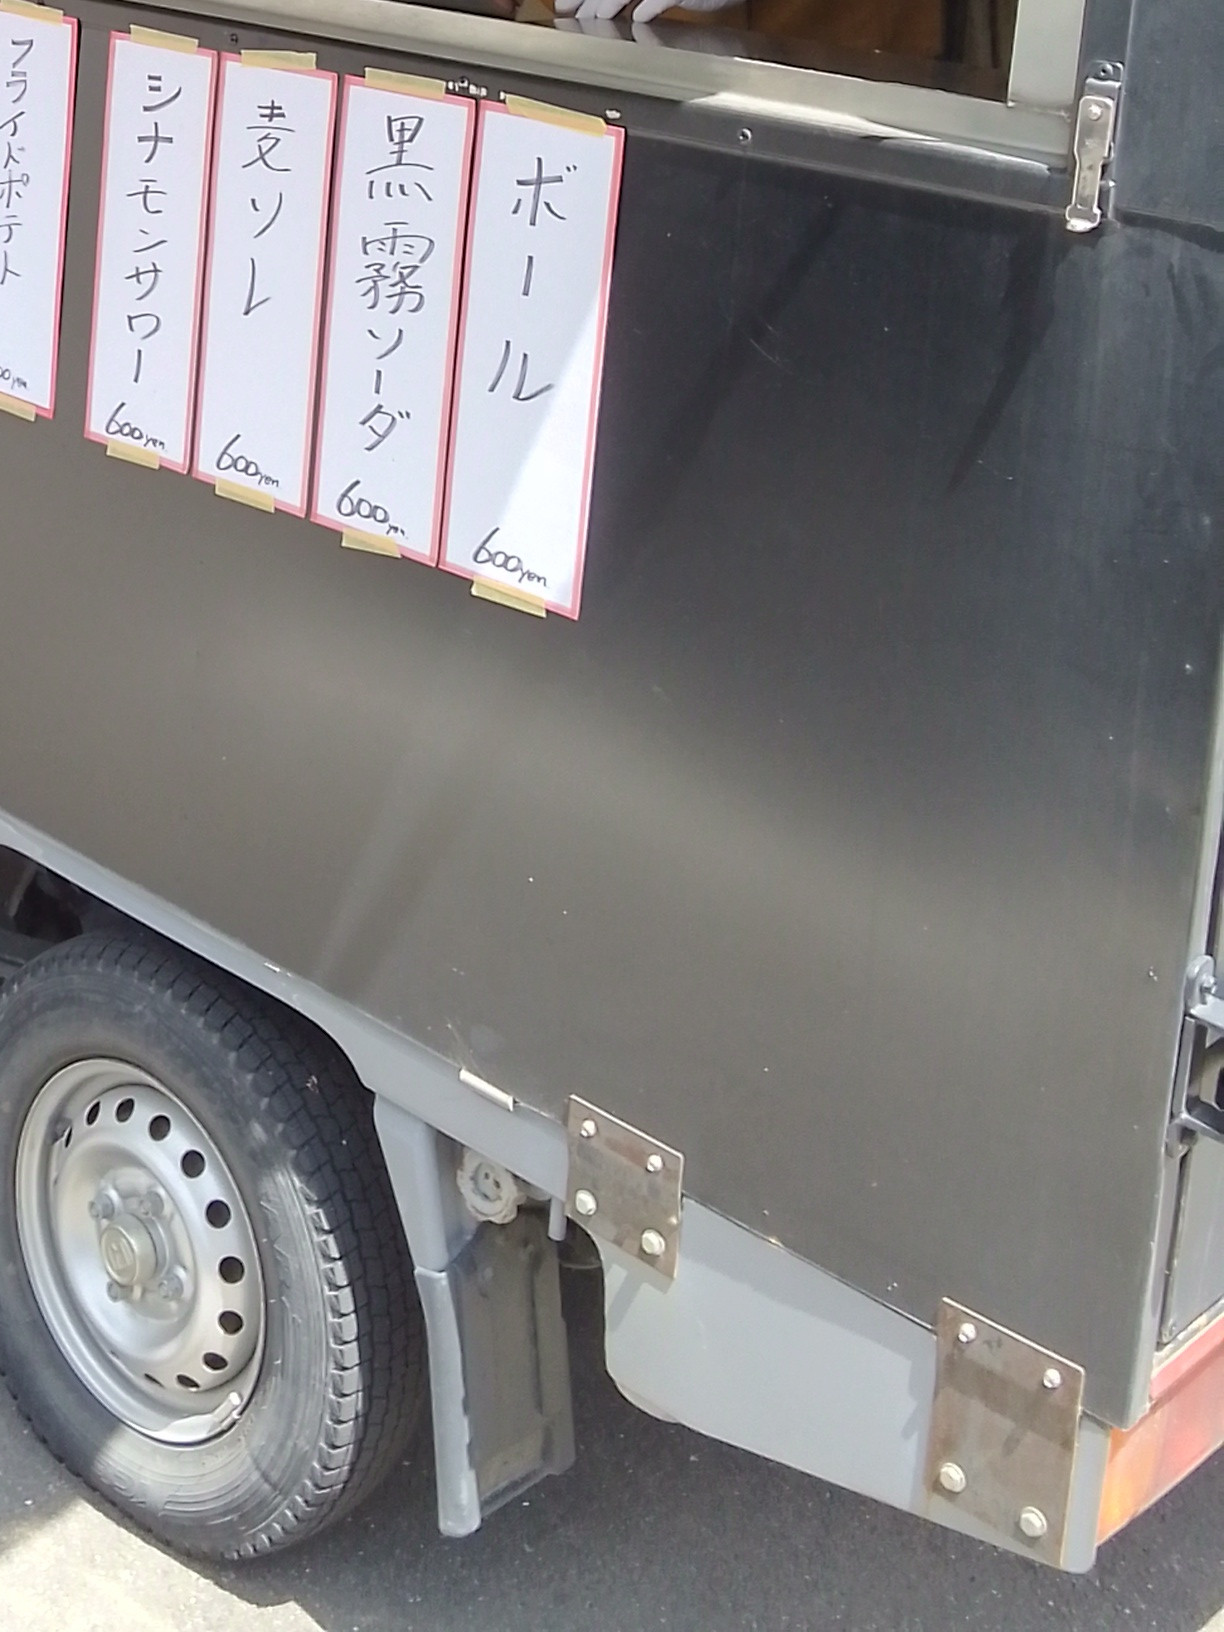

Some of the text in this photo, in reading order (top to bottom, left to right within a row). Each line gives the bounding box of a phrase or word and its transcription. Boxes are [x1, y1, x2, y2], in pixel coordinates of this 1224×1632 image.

[124, 74, 182, 384] シナモンサワー
[355, 113, 436, 453] 黒霧ソーダ
[487, 156, 578, 402] ボール
